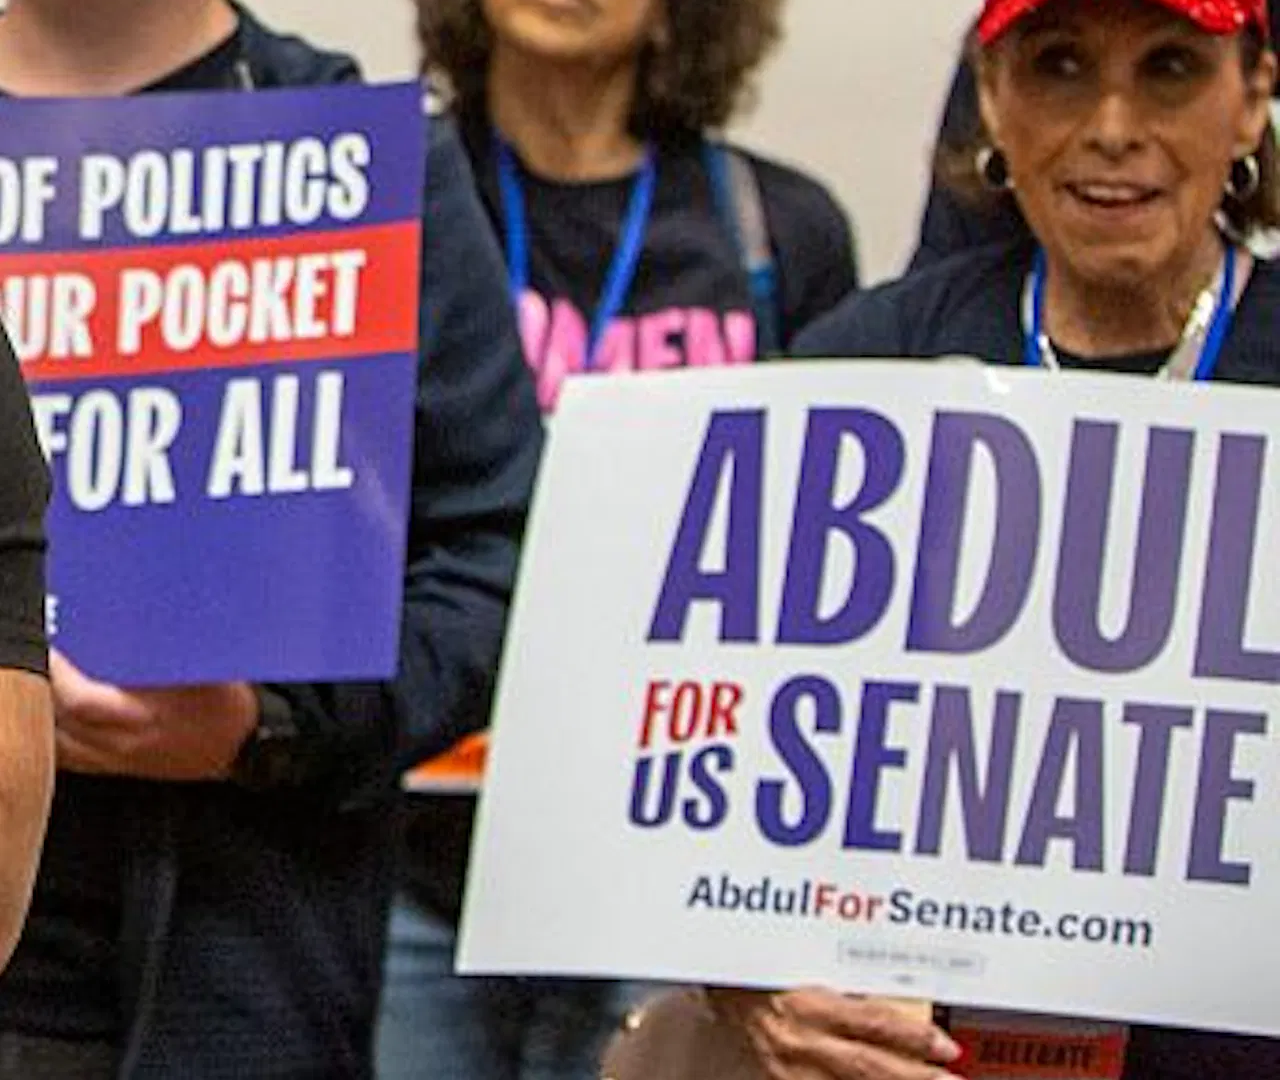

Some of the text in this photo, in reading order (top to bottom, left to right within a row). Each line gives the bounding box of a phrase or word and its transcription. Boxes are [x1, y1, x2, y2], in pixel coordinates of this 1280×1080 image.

[79, 132, 371, 240] POLITICS
[116, 250, 367, 355] POCKET
[30, 371, 355, 512] FOR ALL
[645, 405, 1280, 684] ABDUL
[638, 680, 744, 749] FOR
[627, 673, 1268, 887] US SENATE
[686, 874, 1154, 948] AbdulForSenate.com
